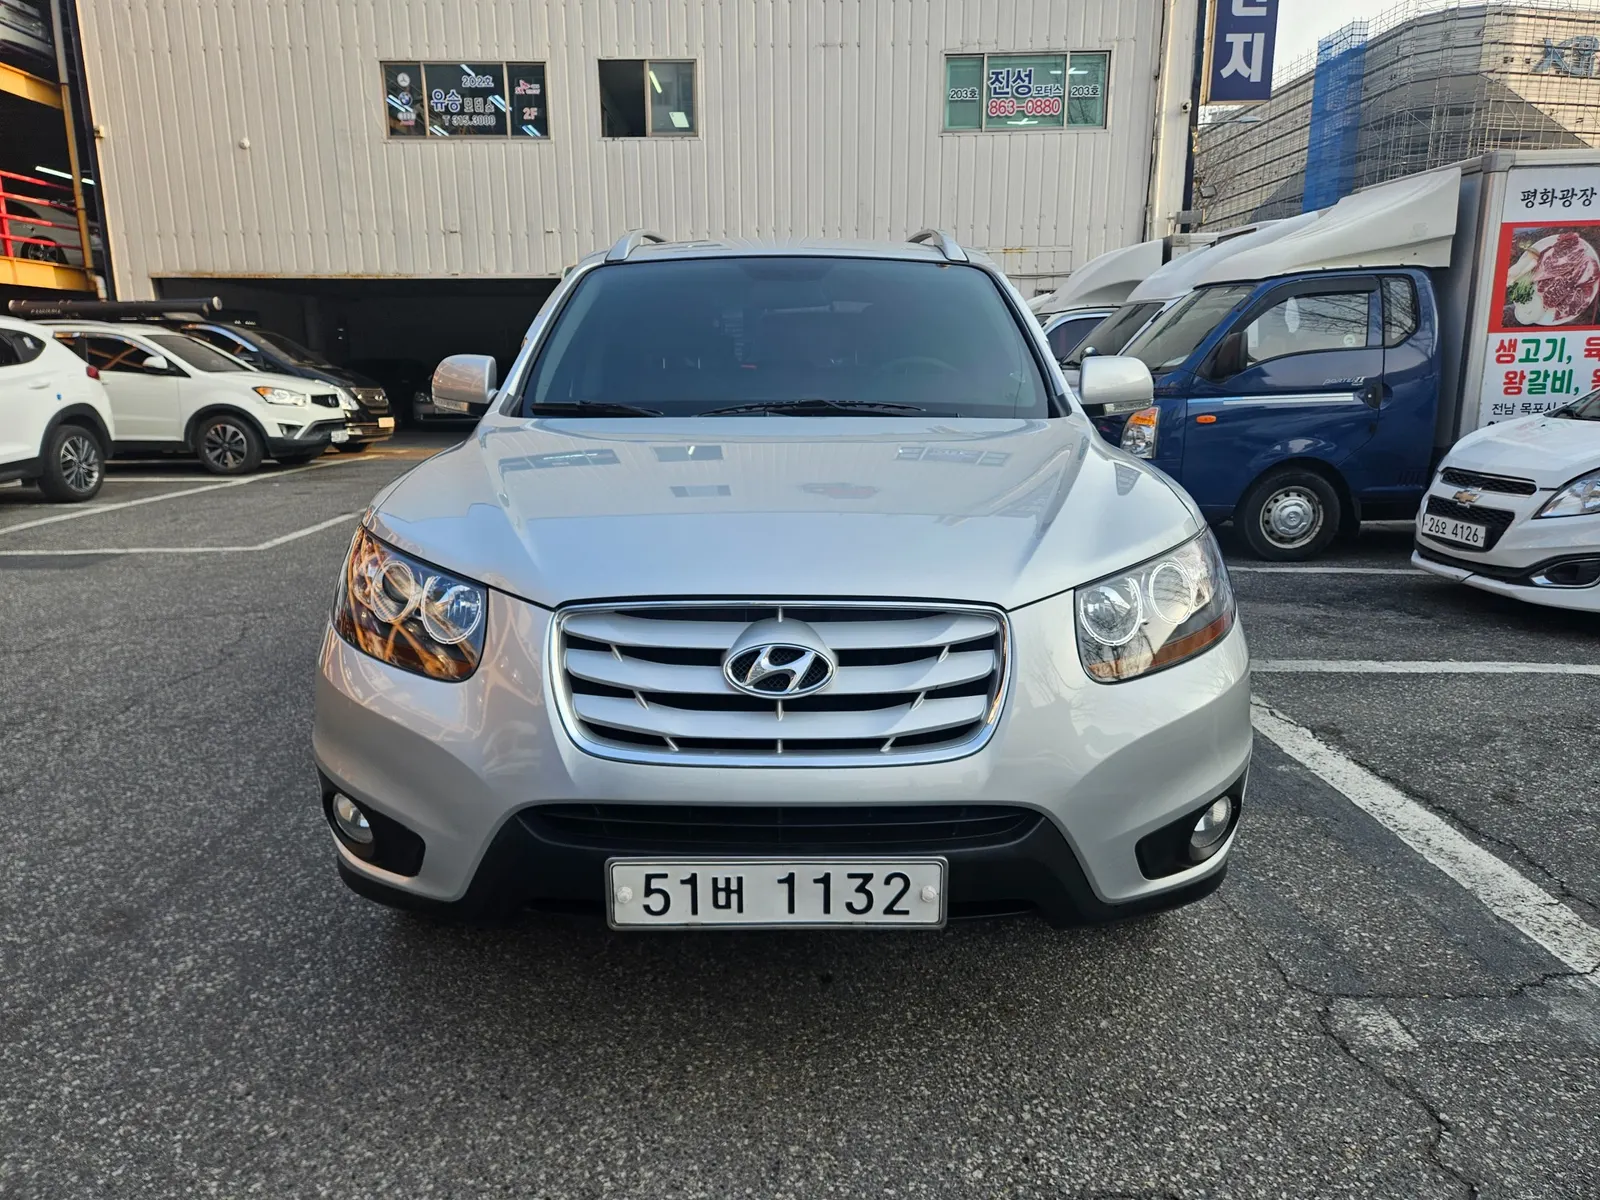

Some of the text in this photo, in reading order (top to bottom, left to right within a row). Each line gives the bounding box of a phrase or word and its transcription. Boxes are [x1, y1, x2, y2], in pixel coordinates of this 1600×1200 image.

[988, 68, 1063, 97] 진성 모터스
[1071, 85, 1100, 97] 203호
[430, 89, 462, 112] 유승
[950, 88, 979, 100] 203호
[522, 107, 538, 120] 2F
[988, 98, 1061, 117] 863-0880
[1520, 187, 1597, 209] 평화광장
[1495, 336, 1572, 364] 생고기,
[1503, 369, 1580, 396] 왕갈비,
[1492, 402, 1516, 416] 전남
[1428, 517, 1479, 543] 26오 4126
[643, 872, 912, 916] 51버 1132
